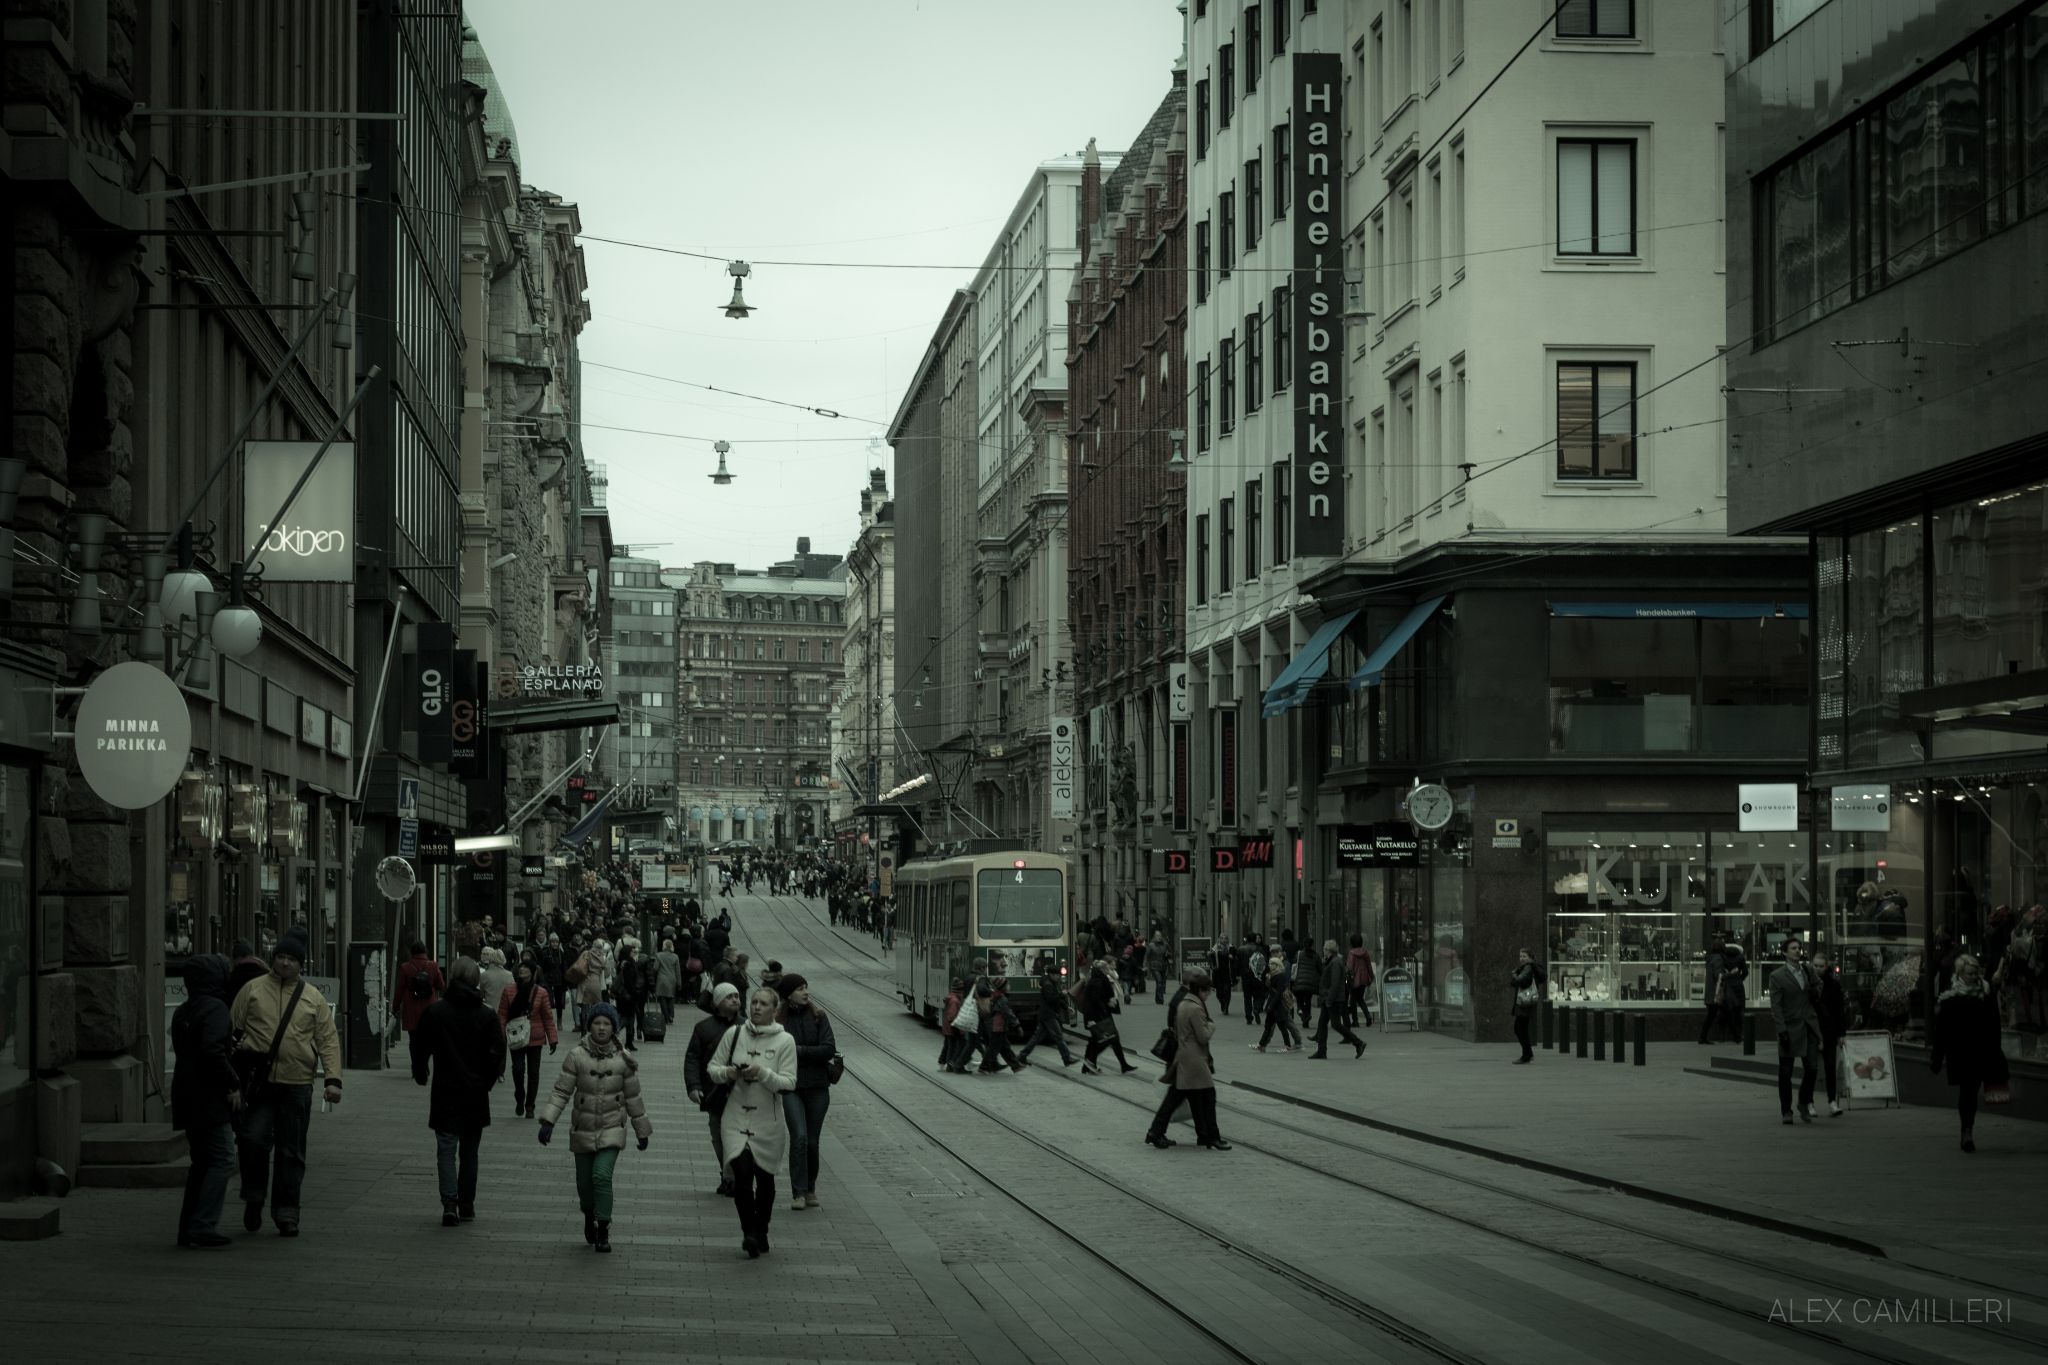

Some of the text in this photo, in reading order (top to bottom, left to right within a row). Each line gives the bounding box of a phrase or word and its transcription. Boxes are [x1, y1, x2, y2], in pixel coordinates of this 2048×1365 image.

[1304, 82, 1331, 518] Handelsbanken
[251, 524, 345, 557] Jokinen
[524, 665, 602, 677] GALLERIA
[421, 668, 442, 717] GLO
[524, 679, 603, 690] ESPLANAD
[105, 719, 160, 732] MINNA
[96, 738, 167, 751] PARIKKA
[1052, 740, 1071, 799] aleksi
[1375, 840, 1418, 850] KULTAKELLO
[1168, 853, 1186, 871] D
[1215, 850, 1234, 870] D
[1014, 869, 1024, 884] 4
